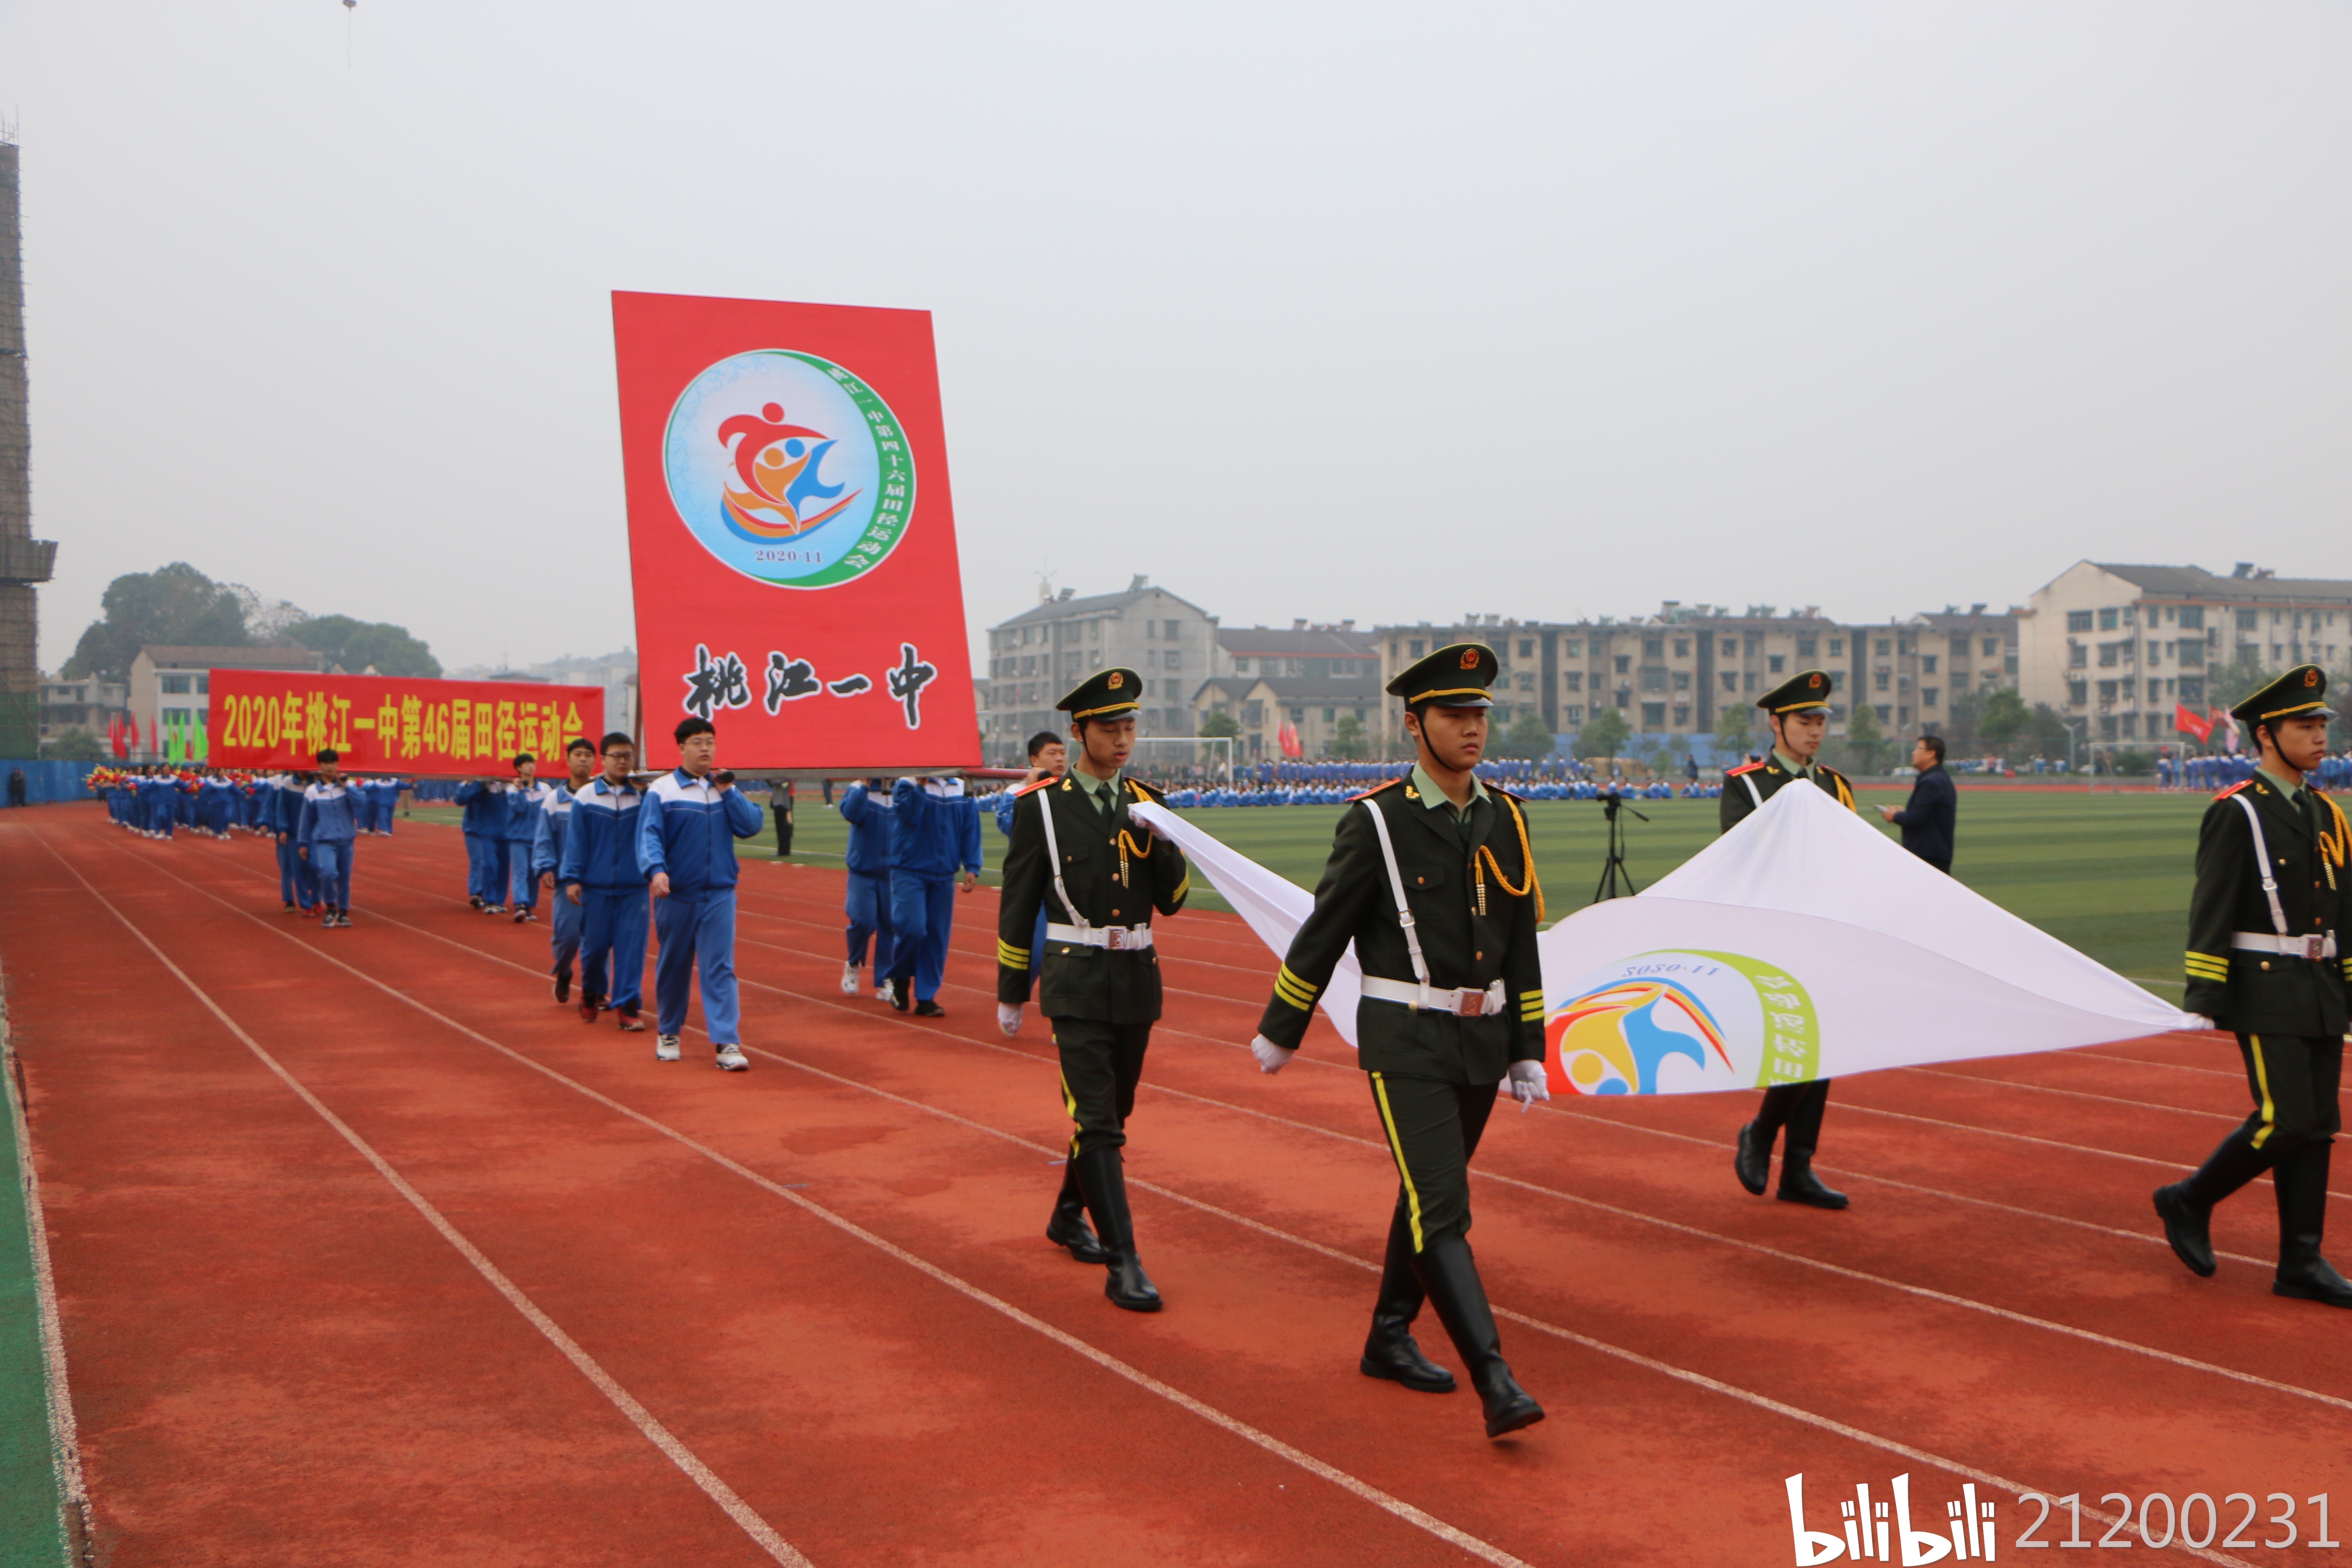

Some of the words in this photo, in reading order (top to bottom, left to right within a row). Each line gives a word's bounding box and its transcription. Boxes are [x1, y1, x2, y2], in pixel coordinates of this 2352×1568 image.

[827, 367, 906, 569] 桃江一中第四十六届田径运动会
[223, 690, 583, 763] 2020年桃江一中第46届田径运动会
[683, 643, 937, 730] 桃江一中
